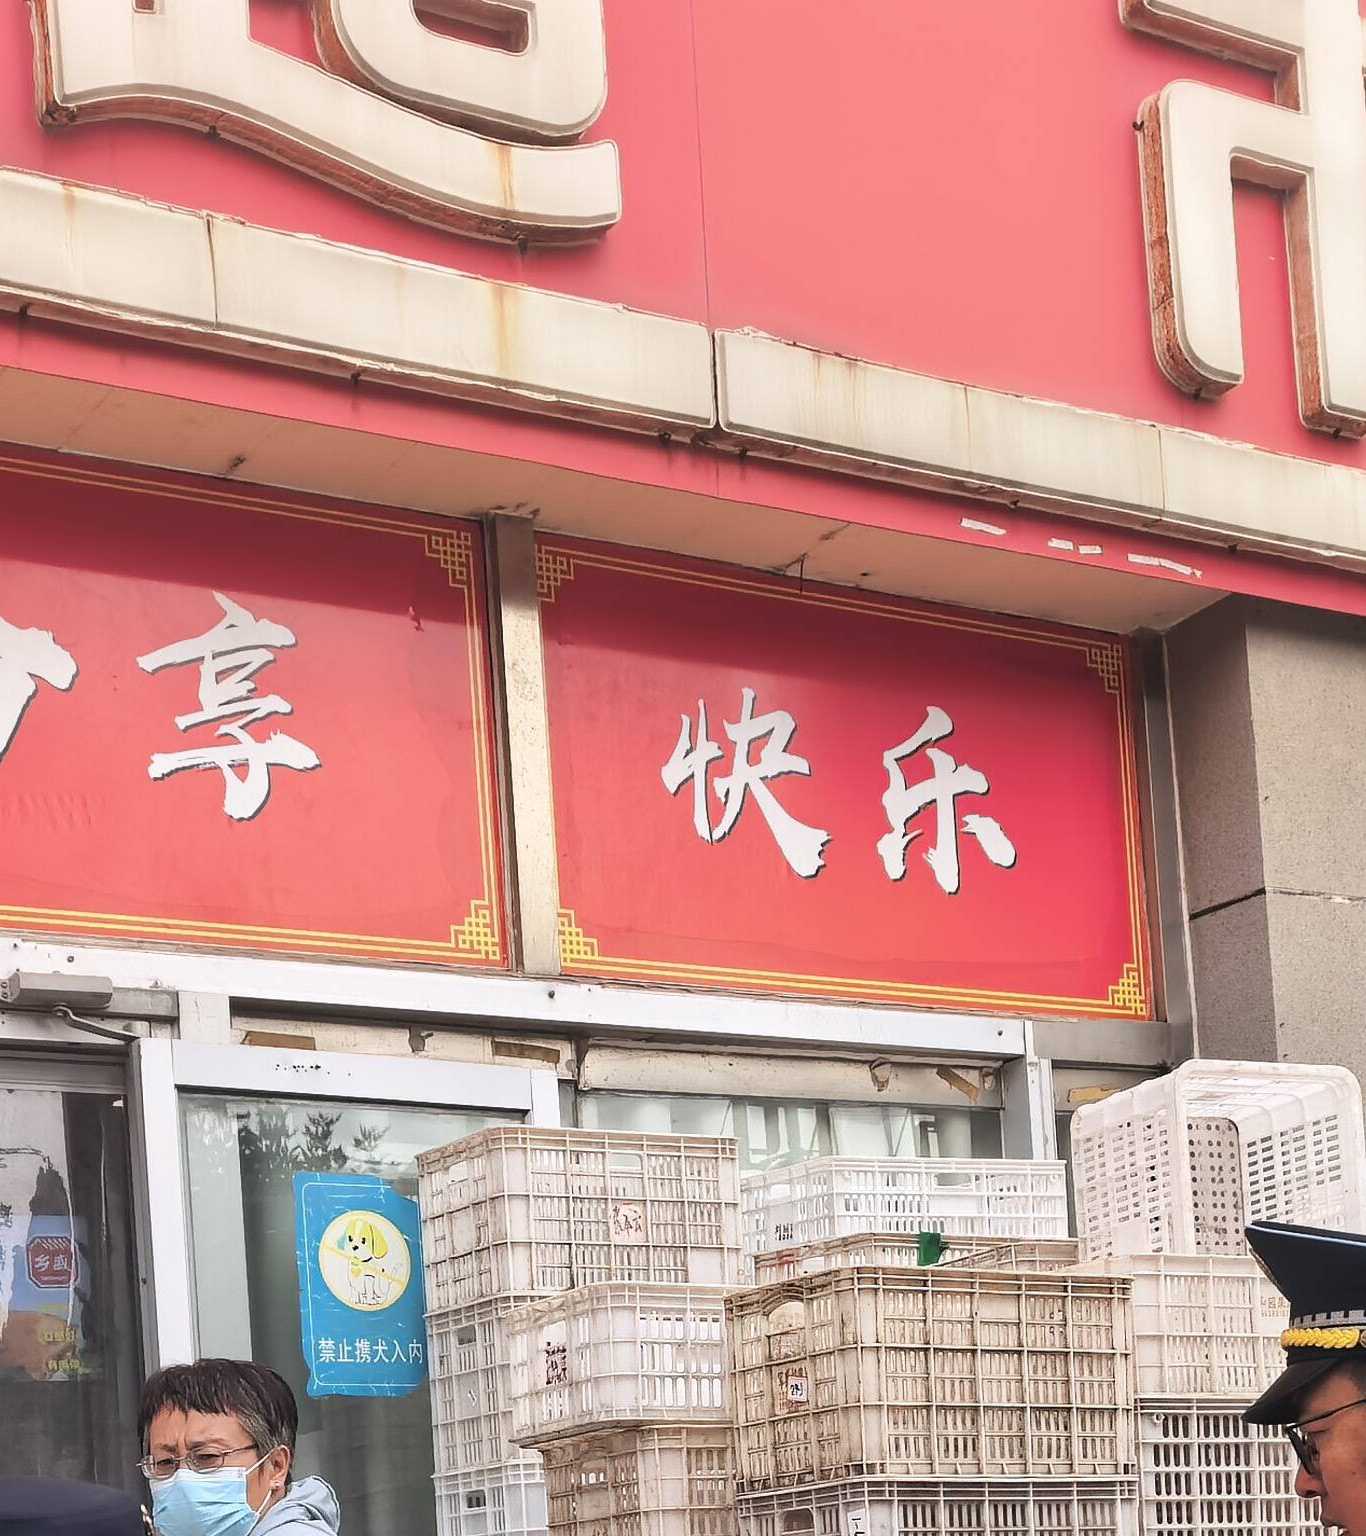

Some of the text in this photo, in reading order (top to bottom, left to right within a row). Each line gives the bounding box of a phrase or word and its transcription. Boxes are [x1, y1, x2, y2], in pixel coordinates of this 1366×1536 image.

[661, 687, 1019, 896] 快乐
[318, 1337, 423, 1364] 禁止携犬入内
